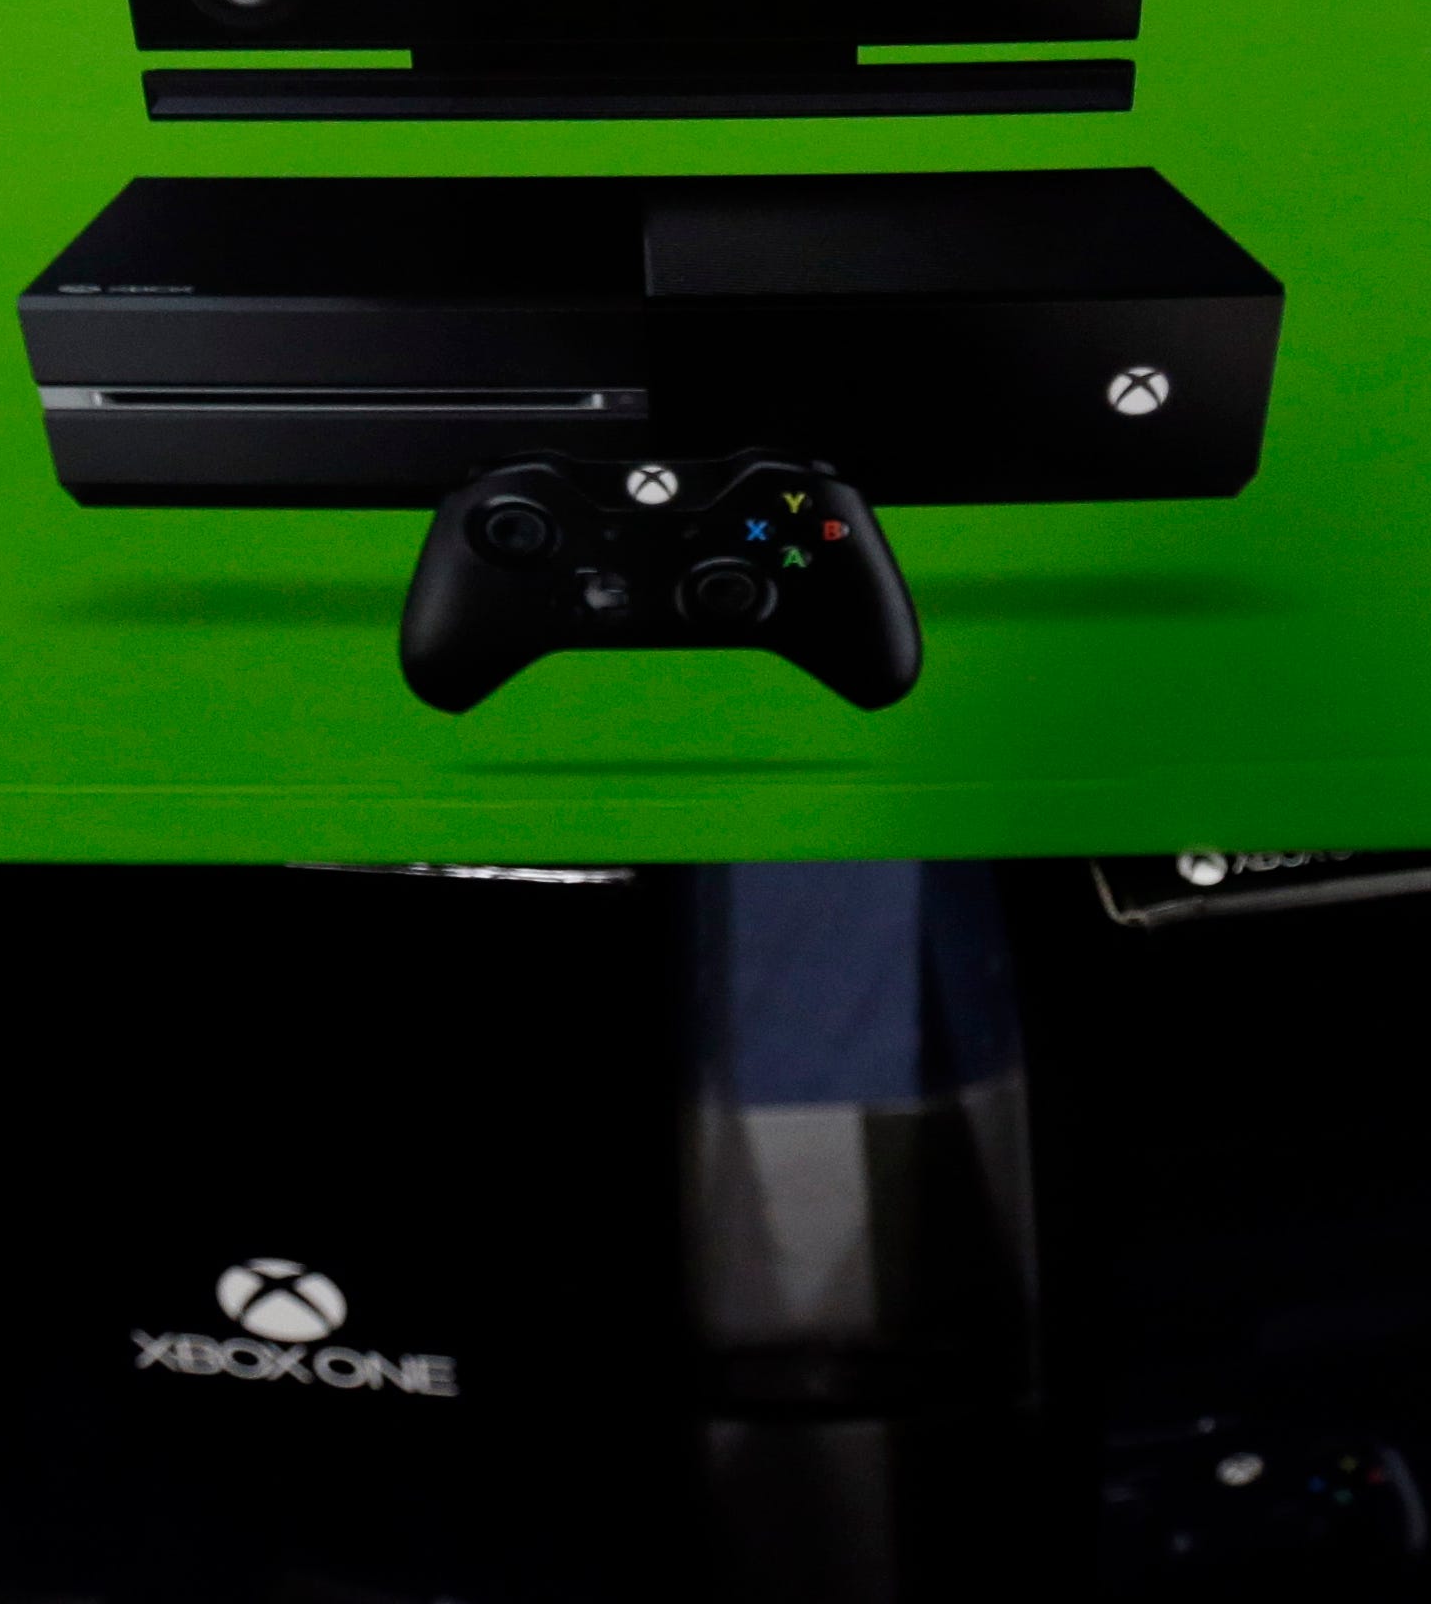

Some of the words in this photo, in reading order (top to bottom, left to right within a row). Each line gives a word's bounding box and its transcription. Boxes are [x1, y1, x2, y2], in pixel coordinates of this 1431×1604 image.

[782, 492, 807, 514] Y
[746, 519, 768, 541] X
[823, 520, 842, 541] B
[782, 546, 807, 568] A
[129, 1327, 315, 1385] XBOX
[312, 1346, 460, 1397] ONE
